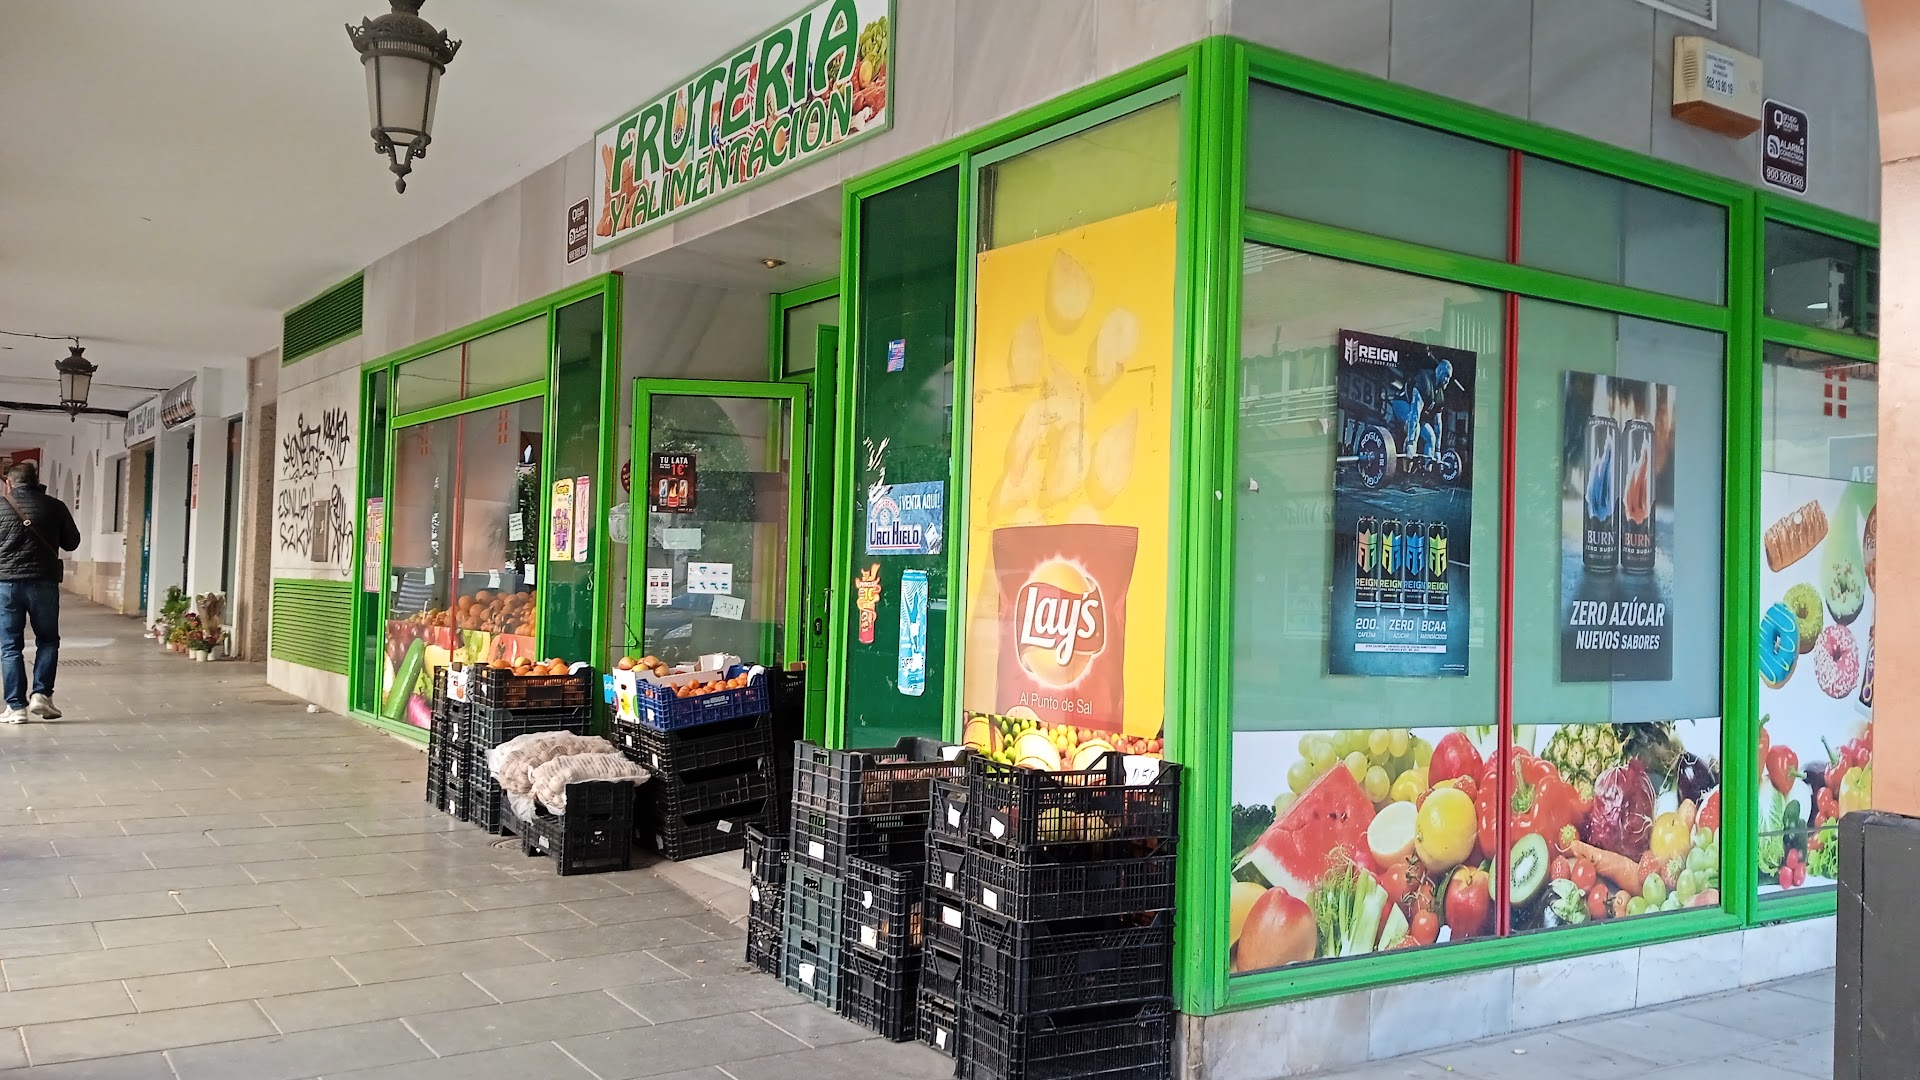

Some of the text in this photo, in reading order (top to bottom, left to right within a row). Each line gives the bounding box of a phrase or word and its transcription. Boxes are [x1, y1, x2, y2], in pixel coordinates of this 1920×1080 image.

[611, 0, 858, 194] FRUTERIA
[1780, 140, 1804, 155] ALARMA
[609, 85, 852, 237] Y ALIMENTACION
[1767, 168, 1804, 188] 900 920 920
[1359, 344, 1398, 363] REIGN
[660, 456, 669, 464] TU
[899, 494, 921, 510] ¡VENTA
[922, 489, 940, 509] AQUÍ!
[892, 521, 919, 545] HIELO
[1587, 530, 1615, 545] BURN
[1625, 533, 1651, 547] BURN
[1355, 578, 1378, 587] REIGN
[1380, 579, 1402, 588] REIGN
[1403, 581, 1426, 589] REIGN
[1427, 582, 1448, 590] REIGN
[1570, 596, 1665, 627] ZERO AZÚCAR
[1020, 587, 1099, 666] Lay's
[1355, 618, 1377, 630] 200
[1389, 619, 1414, 631] ZERO
[1421, 620, 1446, 632] BCAA
[1576, 630, 1660, 650] NUEVOS SABORES
[1019, 692, 1092, 715] Al Punto de Sal
